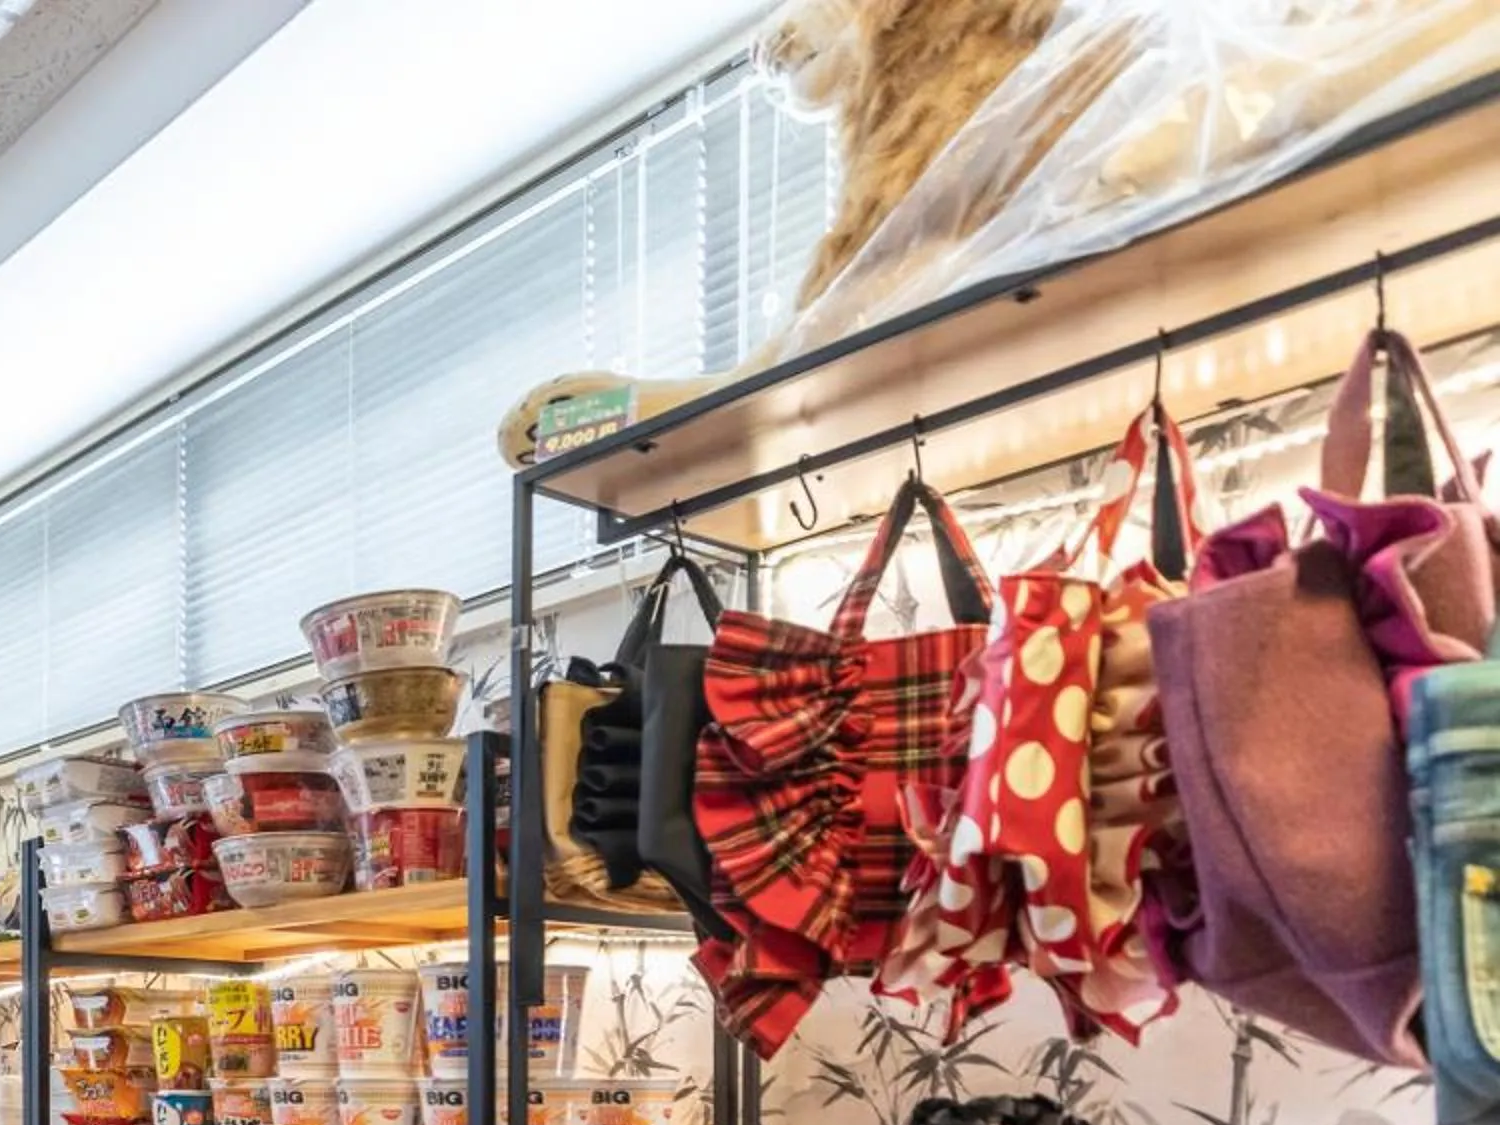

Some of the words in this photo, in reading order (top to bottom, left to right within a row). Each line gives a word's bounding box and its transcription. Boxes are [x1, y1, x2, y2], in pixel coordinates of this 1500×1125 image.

[276, 1025, 320, 1051] RRY
[426, 1090, 463, 1106] BIG
[591, 1090, 631, 1105] BIG
